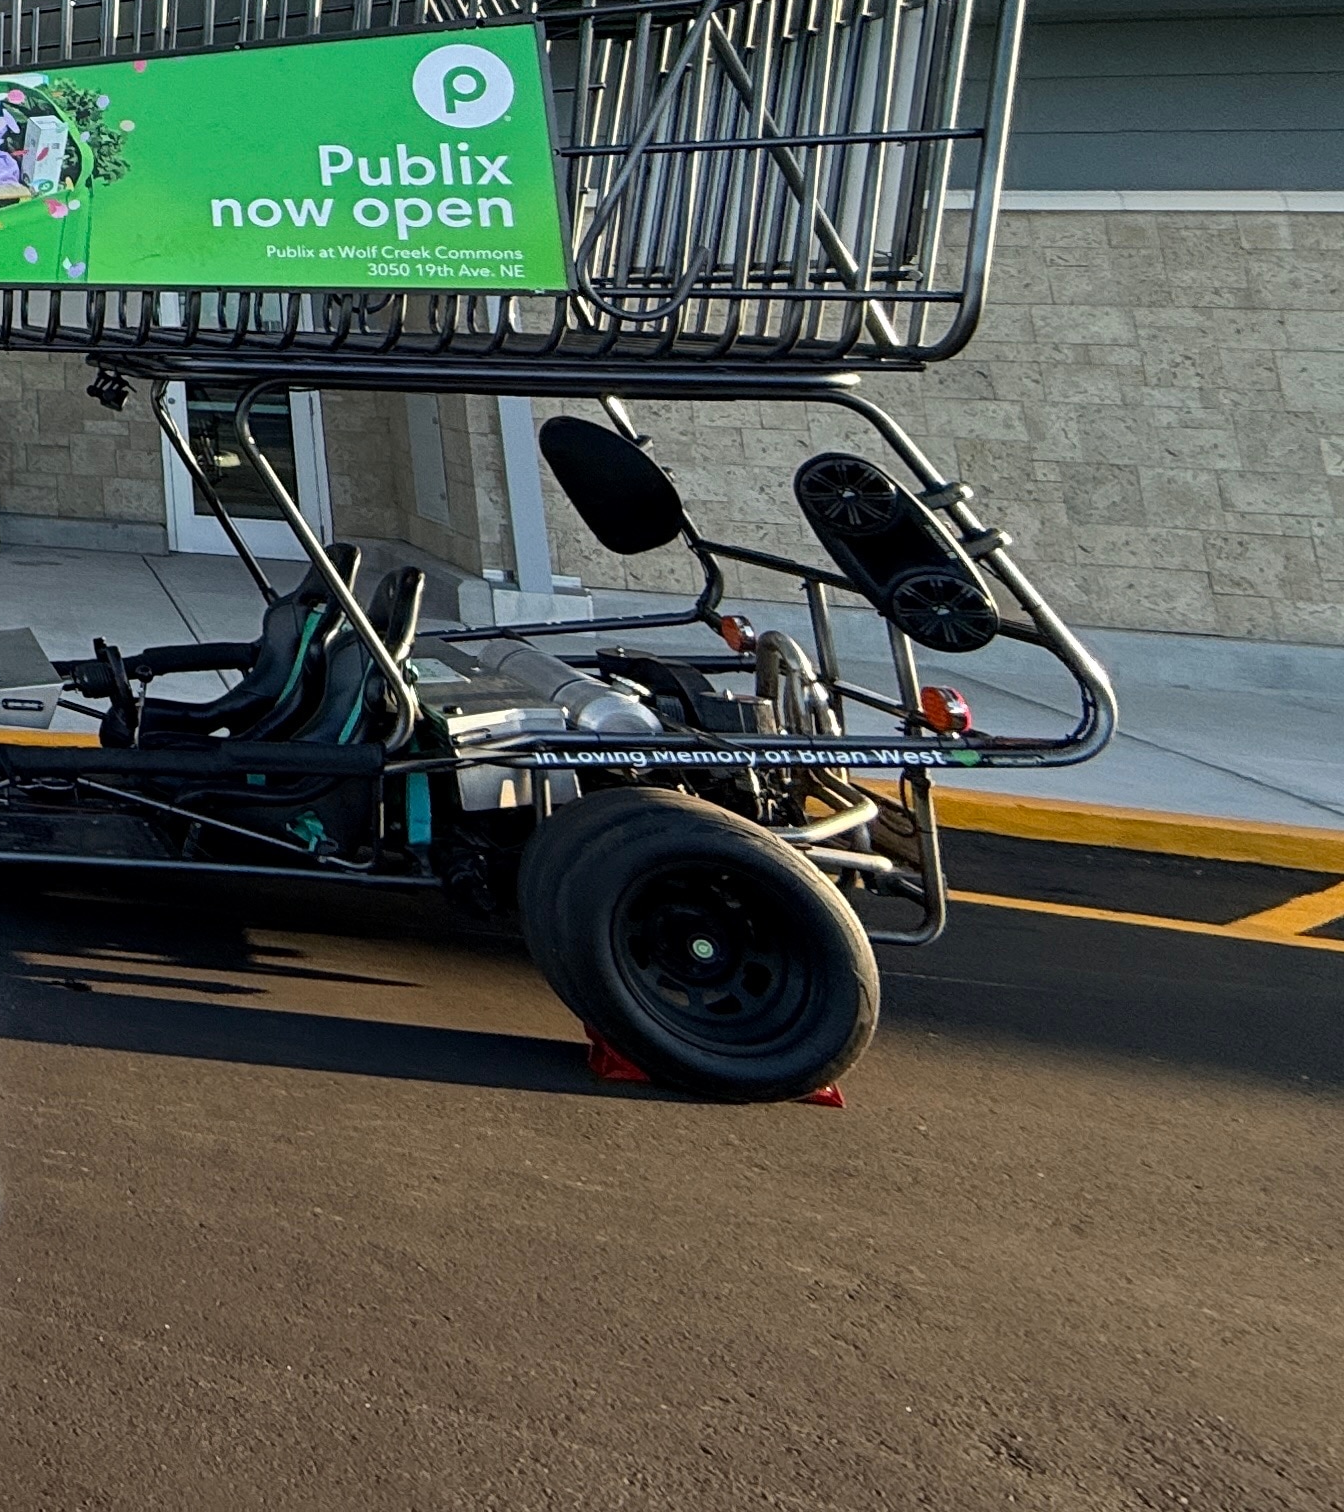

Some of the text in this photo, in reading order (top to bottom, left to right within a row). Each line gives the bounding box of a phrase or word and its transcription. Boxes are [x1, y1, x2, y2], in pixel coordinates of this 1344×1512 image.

[318, 142, 512, 186] Publix
[211, 196, 514, 240] now open
[265, 245, 523, 260] Publix at Wolf Creek Commons
[367, 263, 526, 278] 3050 19th Ave. NE
[535, 749, 947, 767] In Loving Memory of Brian West
